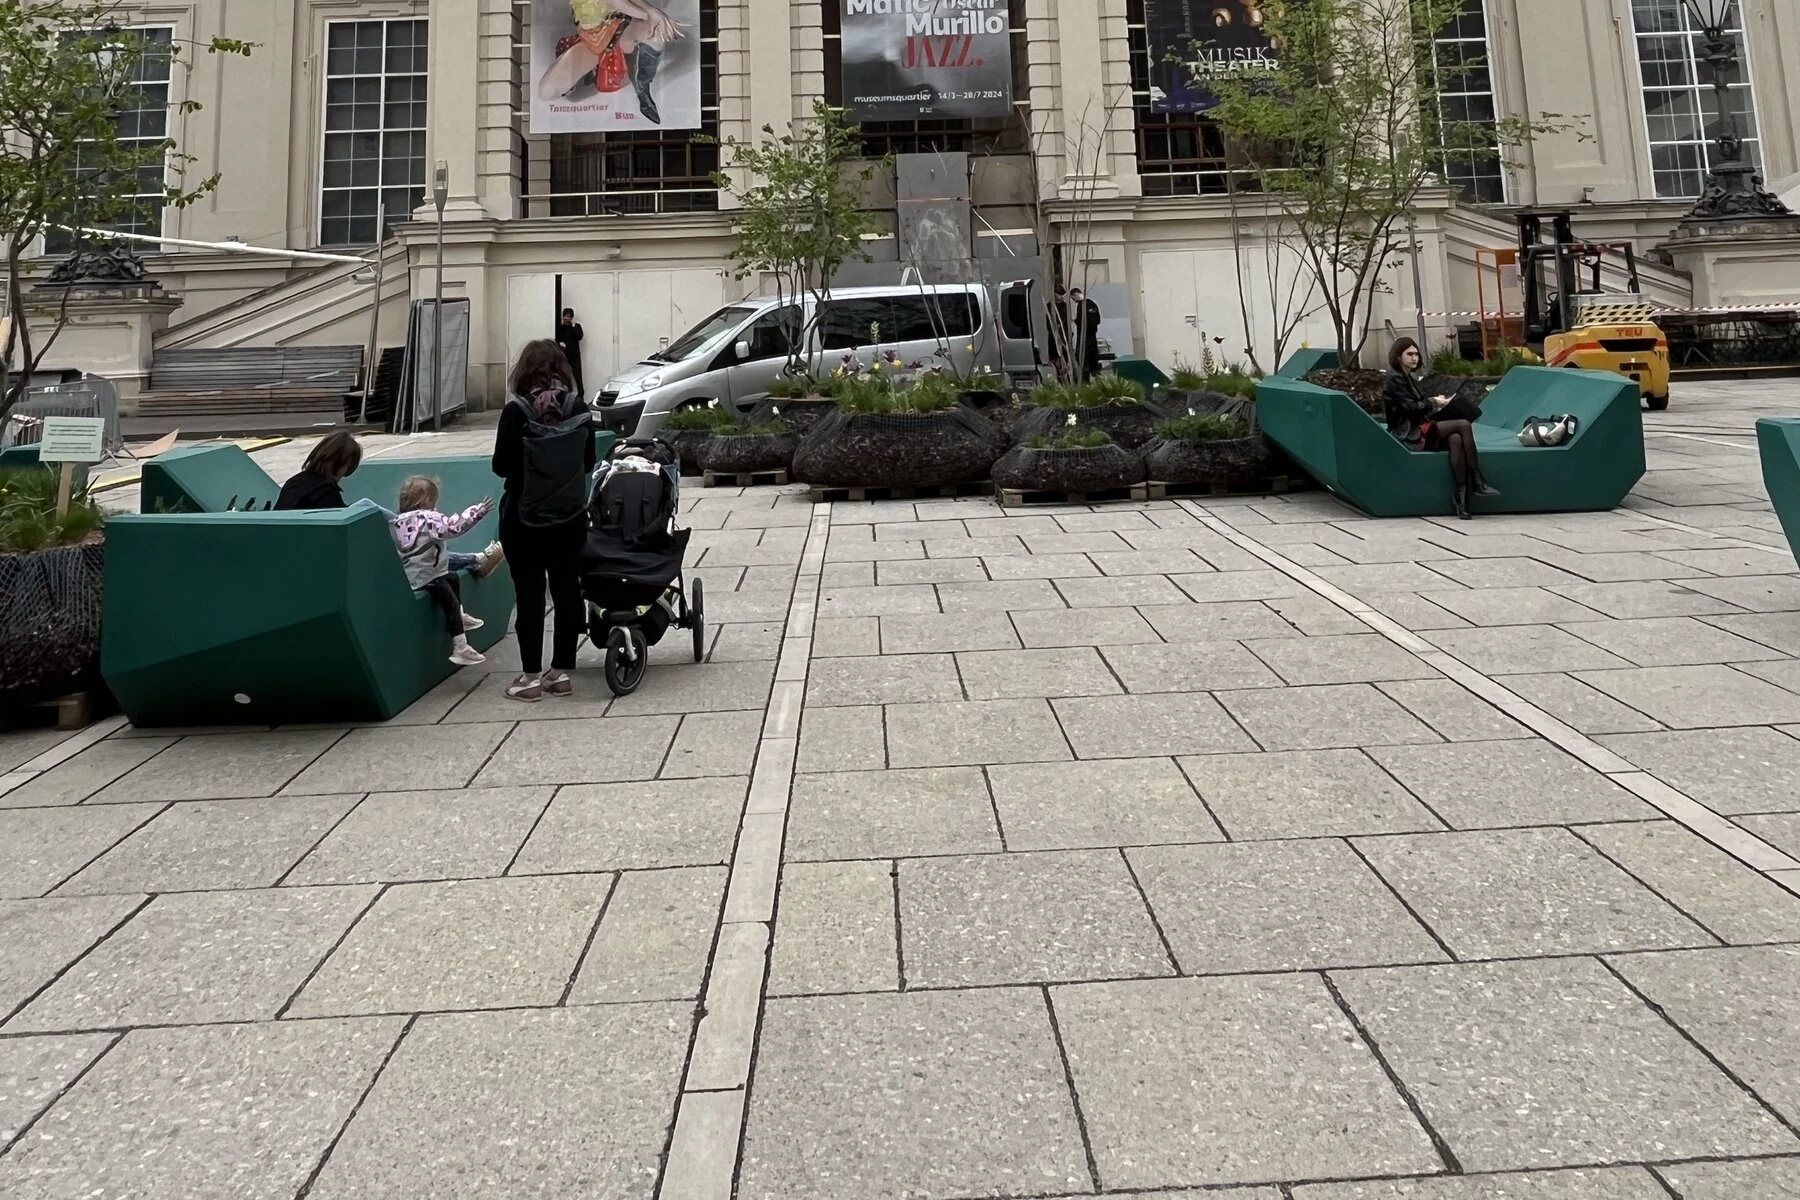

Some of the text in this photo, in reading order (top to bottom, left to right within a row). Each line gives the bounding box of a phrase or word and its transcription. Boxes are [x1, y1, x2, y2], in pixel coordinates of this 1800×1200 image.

[905, 9, 1004, 37] Murillo
[901, 34, 985, 69] JAZZ.
[1197, 46, 1269, 62] MUSIK
[1185, 59, 1281, 74] THEATER
[983, 90, 1003, 99] 2024
